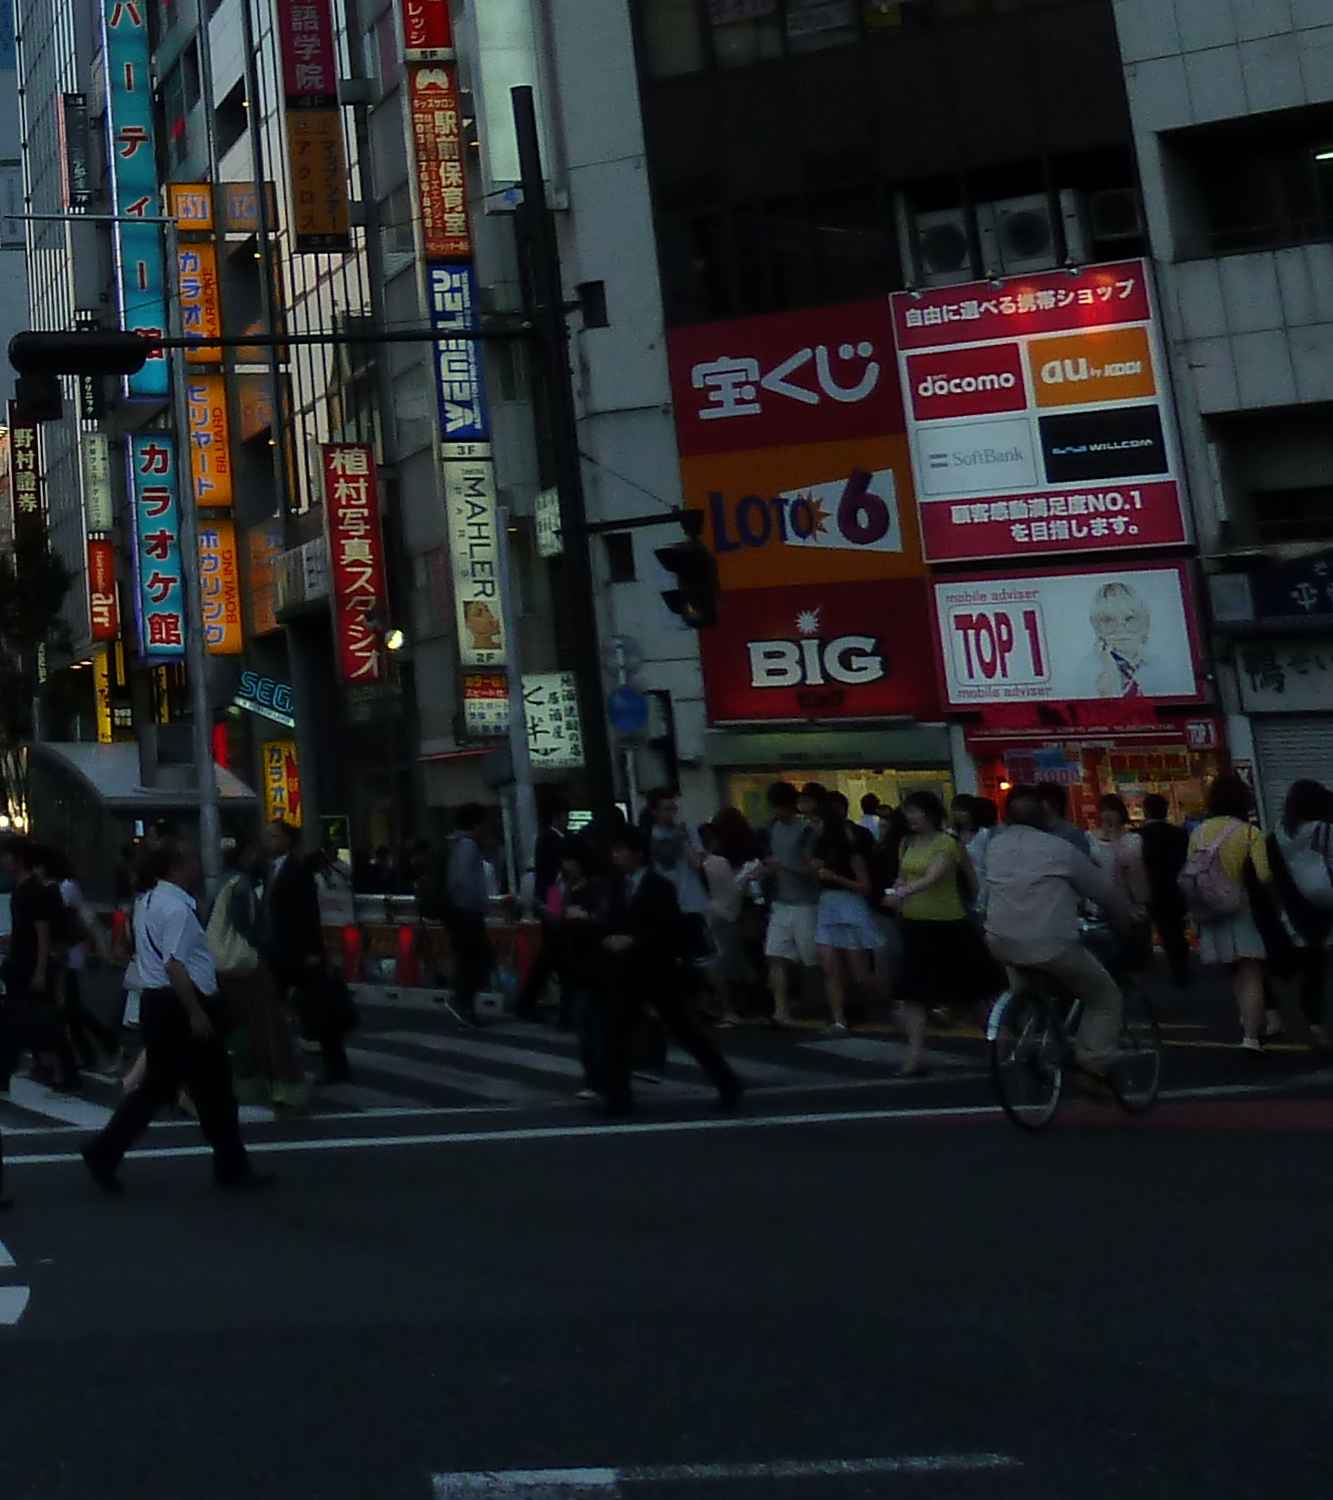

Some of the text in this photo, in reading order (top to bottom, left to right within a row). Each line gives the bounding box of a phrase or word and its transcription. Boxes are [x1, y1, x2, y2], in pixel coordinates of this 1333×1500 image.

[421, 51, 438, 60] 5F
[434, 111, 467, 238] 駅前保育室
[905, 278, 1135, 328] 自由に選べる携帯ショップ
[691, 341, 880, 419] 宝くじ
[918, 372, 1016, 397] docomo
[1041, 358, 1088, 384] au
[189, 386, 215, 498] ビリヤード
[216, 407, 228, 474] BILLIARD
[457, 446, 476, 456] 3F
[953, 448, 1023, 467] SoftBank
[1089, 438, 1153, 451] WILLCOM
[14, 428, 38, 513] 野村證券
[708, 467, 890, 553] LOTO 6
[1010, 516, 1139, 542] を目指します。
[140, 445, 182, 647] カラオケ館
[464, 476, 495, 599] MAHLER
[201, 529, 226, 646] ボウリング
[226, 549, 238, 625] BOWLING
[946, 588, 1039, 603] mobile adviser
[476, 653, 495, 663] 2F
[746, 635, 886, 687] BIG
[954, 610, 1044, 679] TOP 1
[958, 685, 1052, 698] mobile adviser
